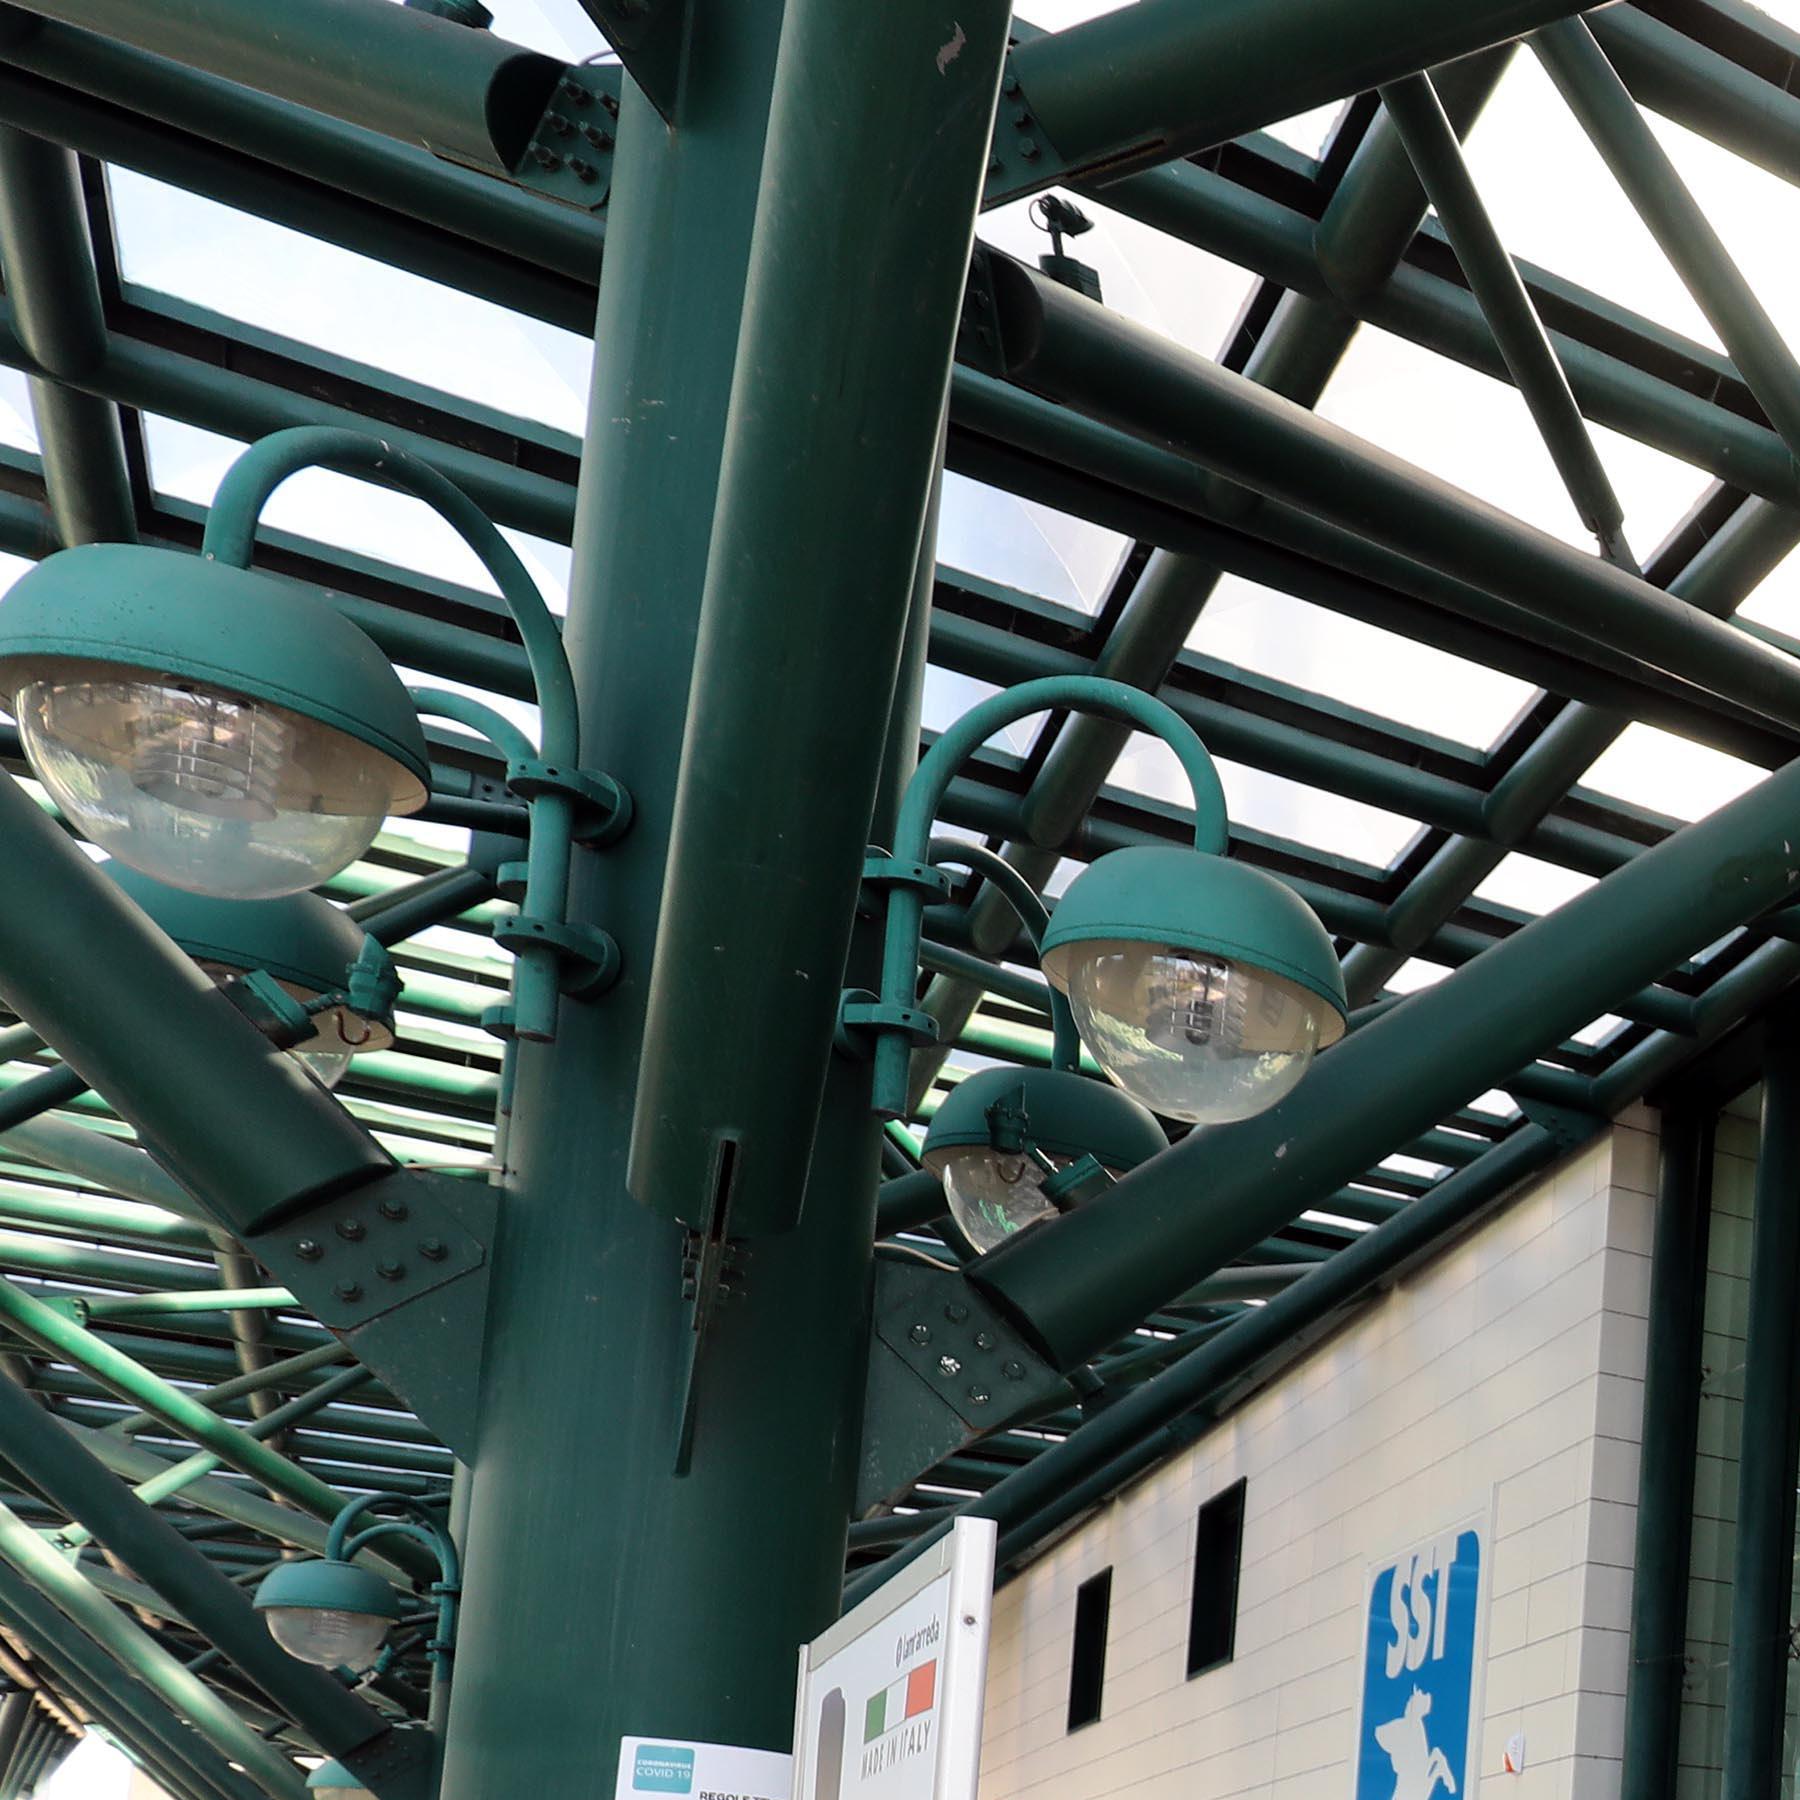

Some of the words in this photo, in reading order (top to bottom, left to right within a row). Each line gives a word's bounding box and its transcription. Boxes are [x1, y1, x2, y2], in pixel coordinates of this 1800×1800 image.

[1386, 1533, 1459, 1680] SST
[636, 1768, 674, 1779] COVID
[677, 1770, 691, 1780] 19
[861, 1740, 884, 1781] MADE
[887, 1735, 897, 1767] IN
[900, 1719, 931, 1761] ITALY
